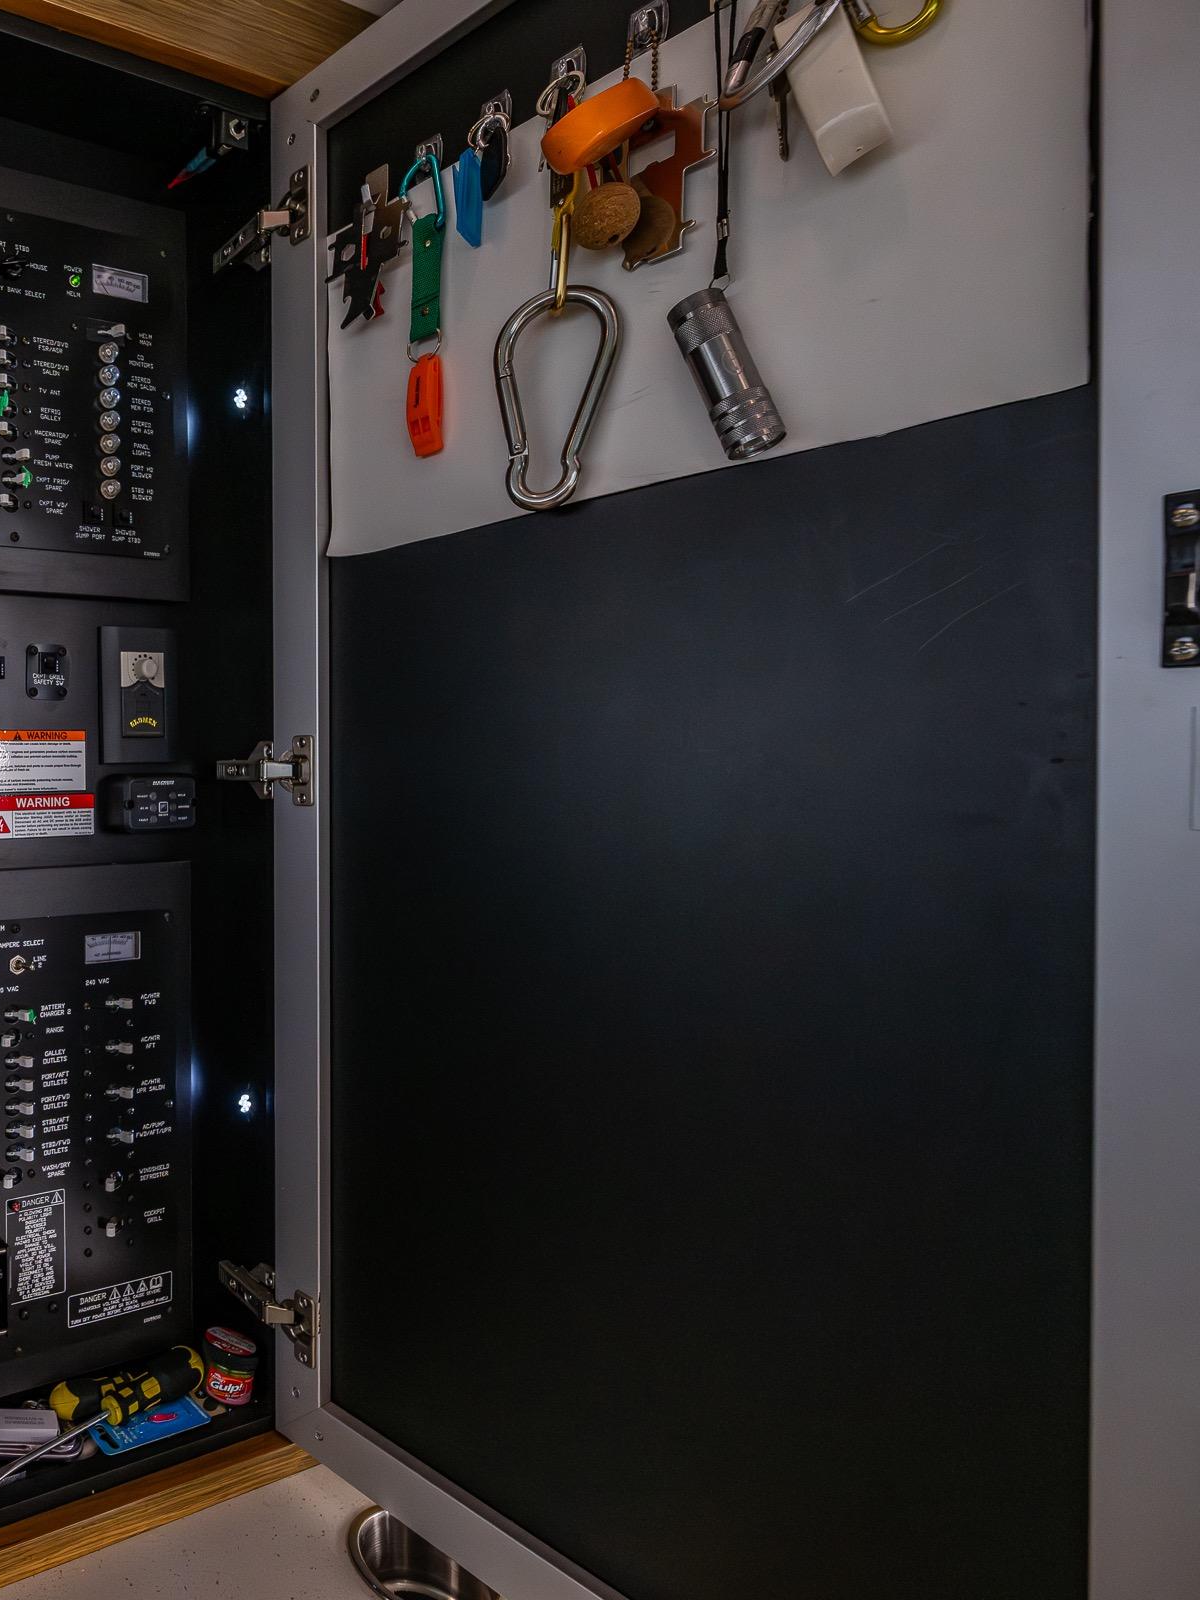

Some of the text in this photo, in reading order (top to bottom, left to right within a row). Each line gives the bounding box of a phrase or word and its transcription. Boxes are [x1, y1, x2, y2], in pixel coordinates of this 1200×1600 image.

[15, 244, 30, 252] STBD
[30, 262, 48, 271] HOUSE
[64, 265, 82, 273] POWER
[7, 286, 21, 294] BANK
[24, 290, 46, 299] SELECT
[27, 732, 67, 740] WARNING
[16, 797, 70, 808] WARNING
[23, 939, 44, 947] SELECT
[41, 1003, 65, 1011] BATTERY
[40, 1010, 64, 1018] CHARGER
[46, 1026, 64, 1034] RANGE
[43, 1056, 67, 1064] OUTLETS
[43, 1079, 67, 1087] OUTLETS
[43, 1101, 68, 1110] OUTLETS
[43, 1124, 68, 1133] OUTLETS
[44, 1147, 68, 1156] OUTLETS
[47, 1170, 65, 1178] SPARE
[22, 1196, 49, 1207] DANGER
[80, 1292, 107, 1305] DANGER
[210, 1380, 243, 1393] Gulp!
